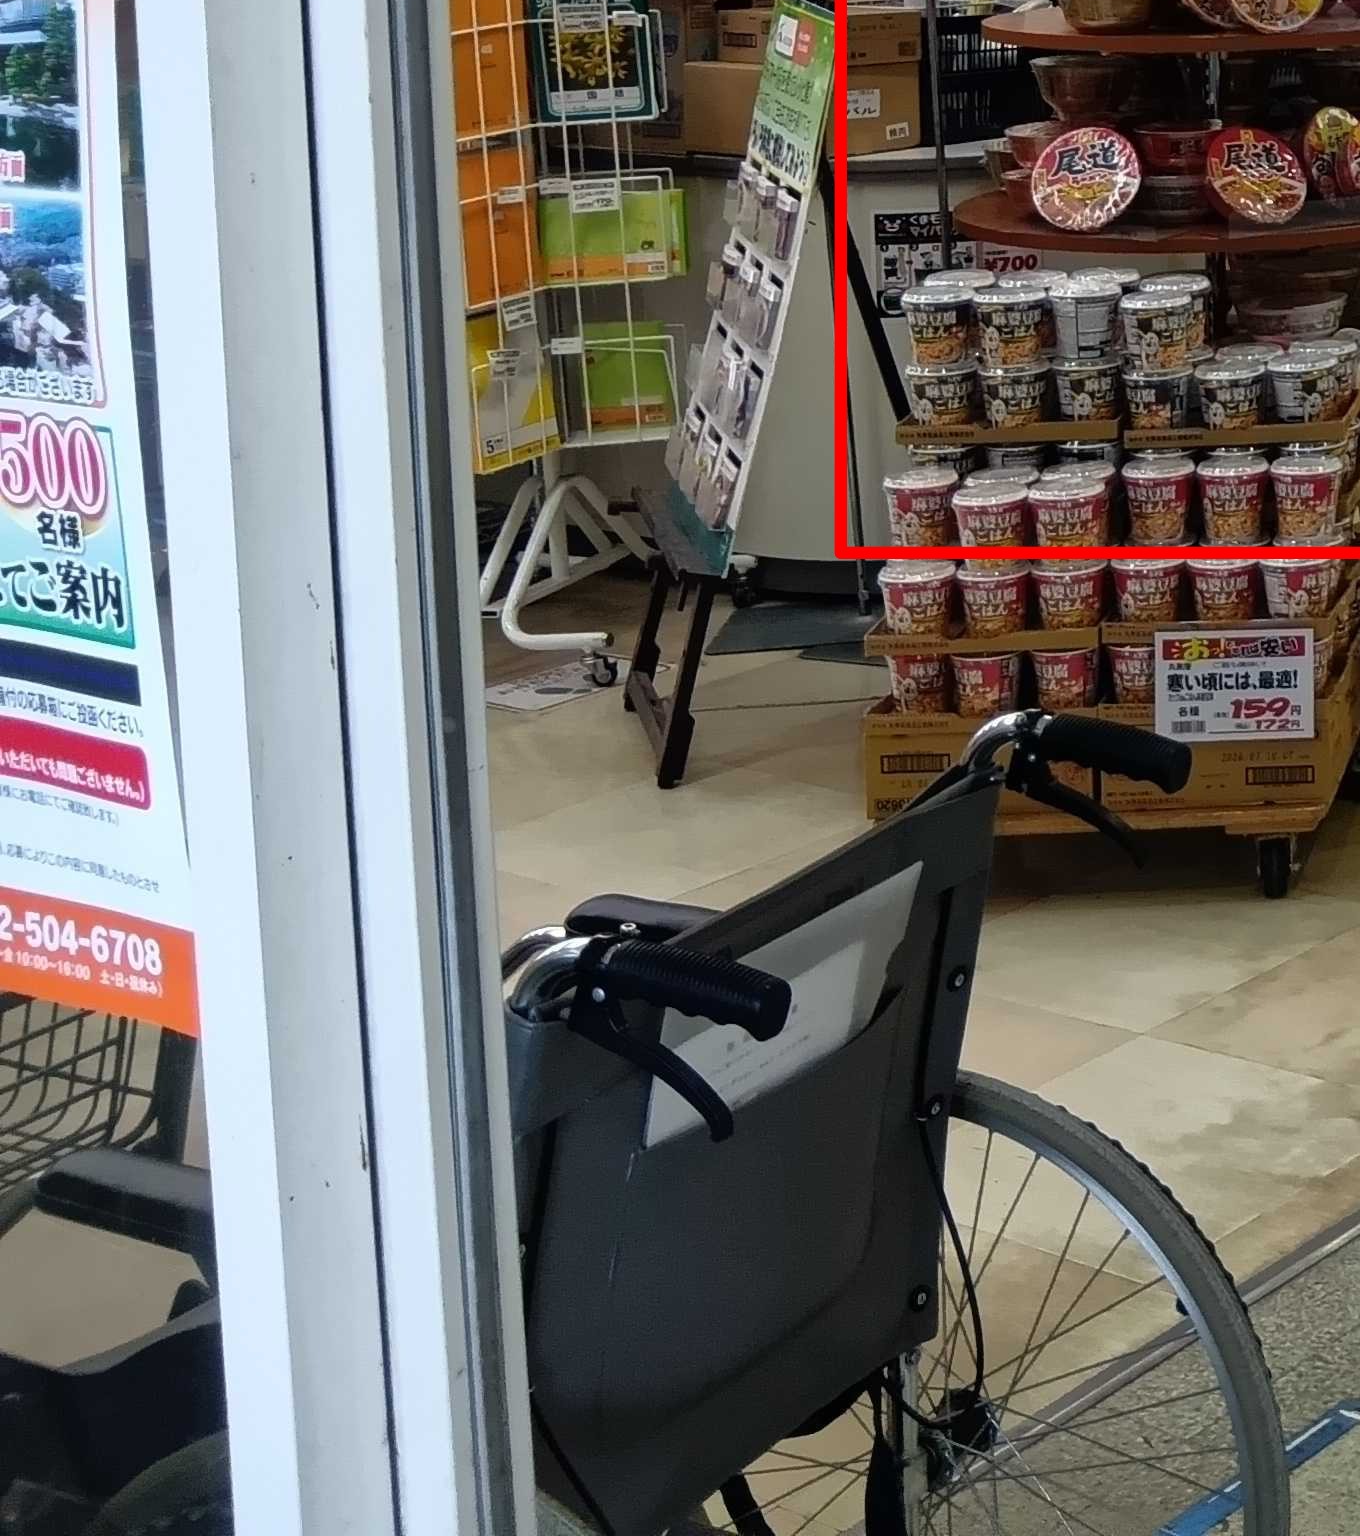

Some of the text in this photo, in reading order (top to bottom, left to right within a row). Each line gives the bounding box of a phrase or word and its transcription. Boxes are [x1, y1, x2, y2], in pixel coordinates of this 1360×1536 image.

[1057, 140, 1118, 176] 尾道
[1224, 142, 1284, 170] 尾道
[37, 510, 81, 550] 名様
[1167, 669, 1298, 692] 寒い頃には、最適!
